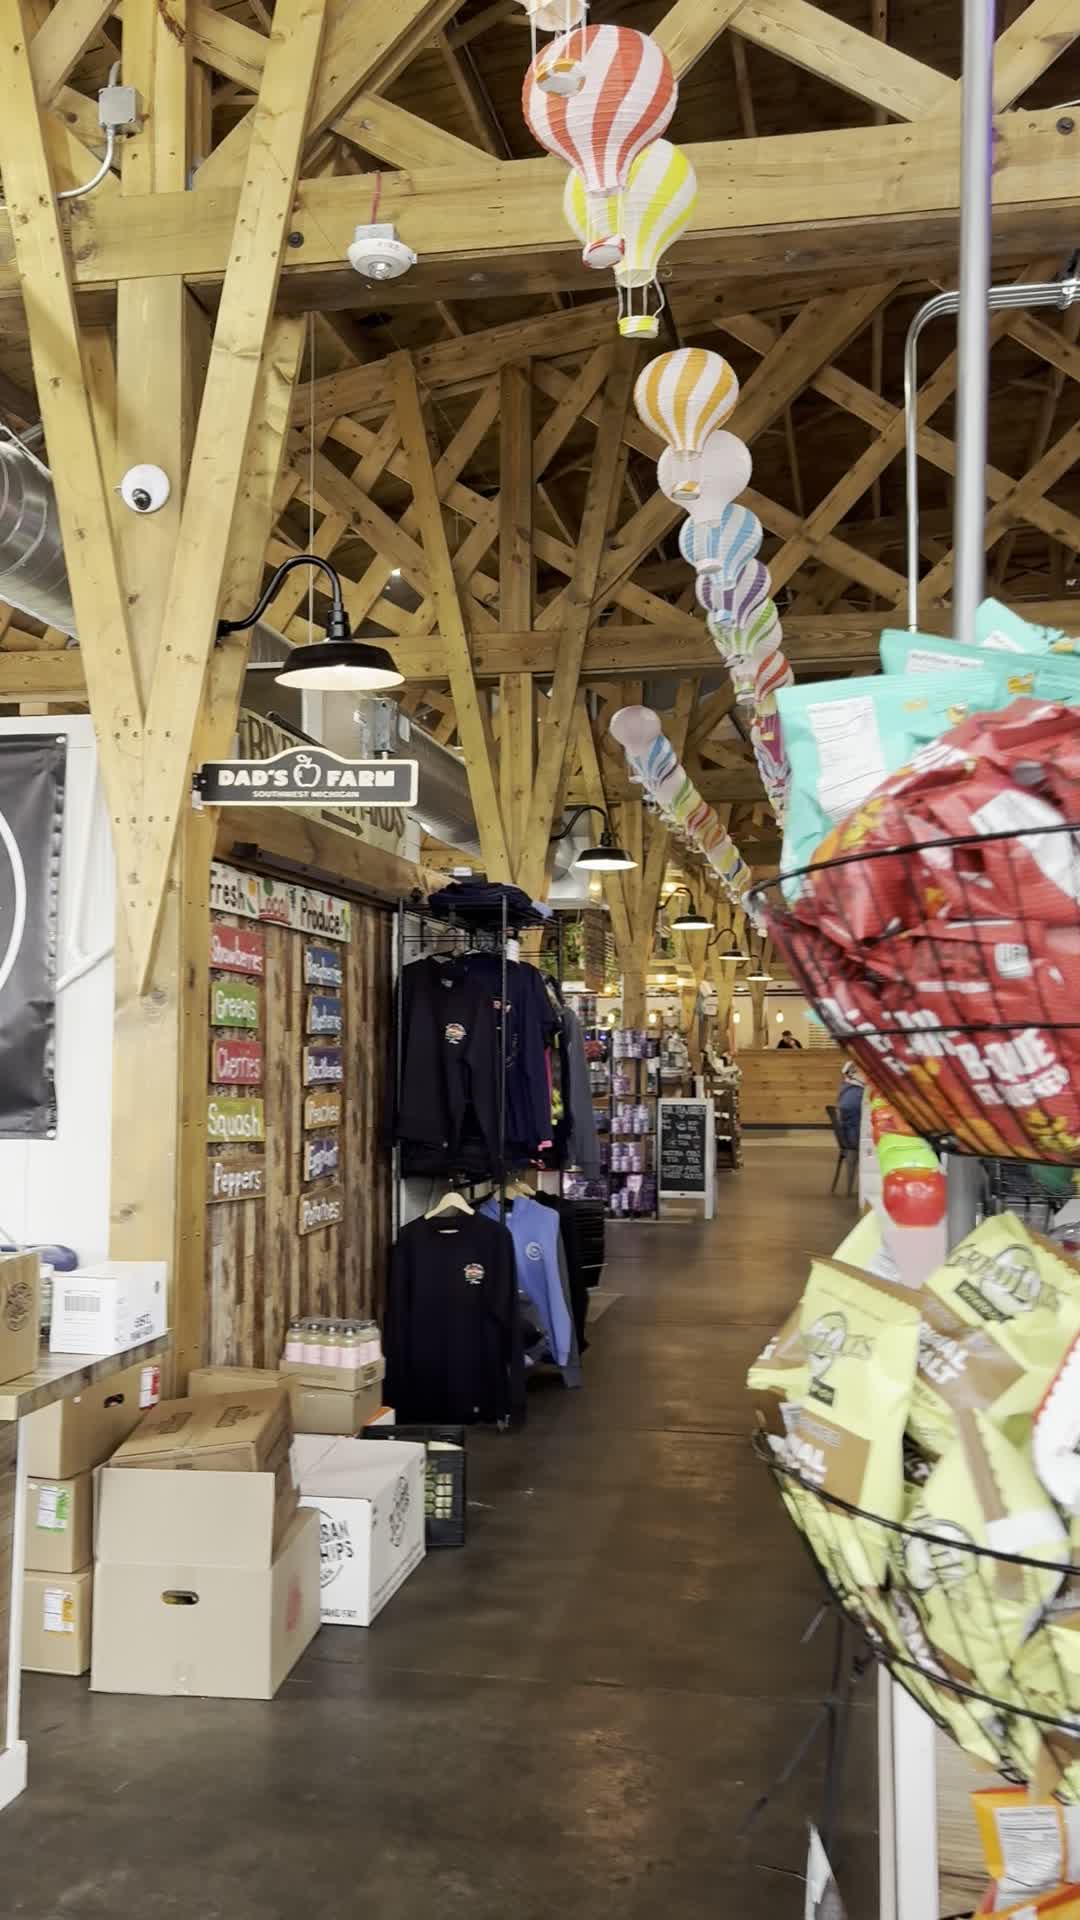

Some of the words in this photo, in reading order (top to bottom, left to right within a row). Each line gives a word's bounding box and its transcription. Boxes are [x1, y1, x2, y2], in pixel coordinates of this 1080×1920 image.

[217, 769, 289, 787] DAD'S
[326, 770, 395, 787] FARM
[252, 790, 310, 798] SOUTHWEST
[311, 790, 360, 798] MICHIGAN
[210, 870, 245, 911] Fresh
[216, 990, 257, 1020] Greens
[217, 1047, 262, 1079] Cherries
[208, 1103, 261, 1142] Squash
[213, 1162, 263, 1197] Peppers
[319, 1540, 355, 1563] HIPS
